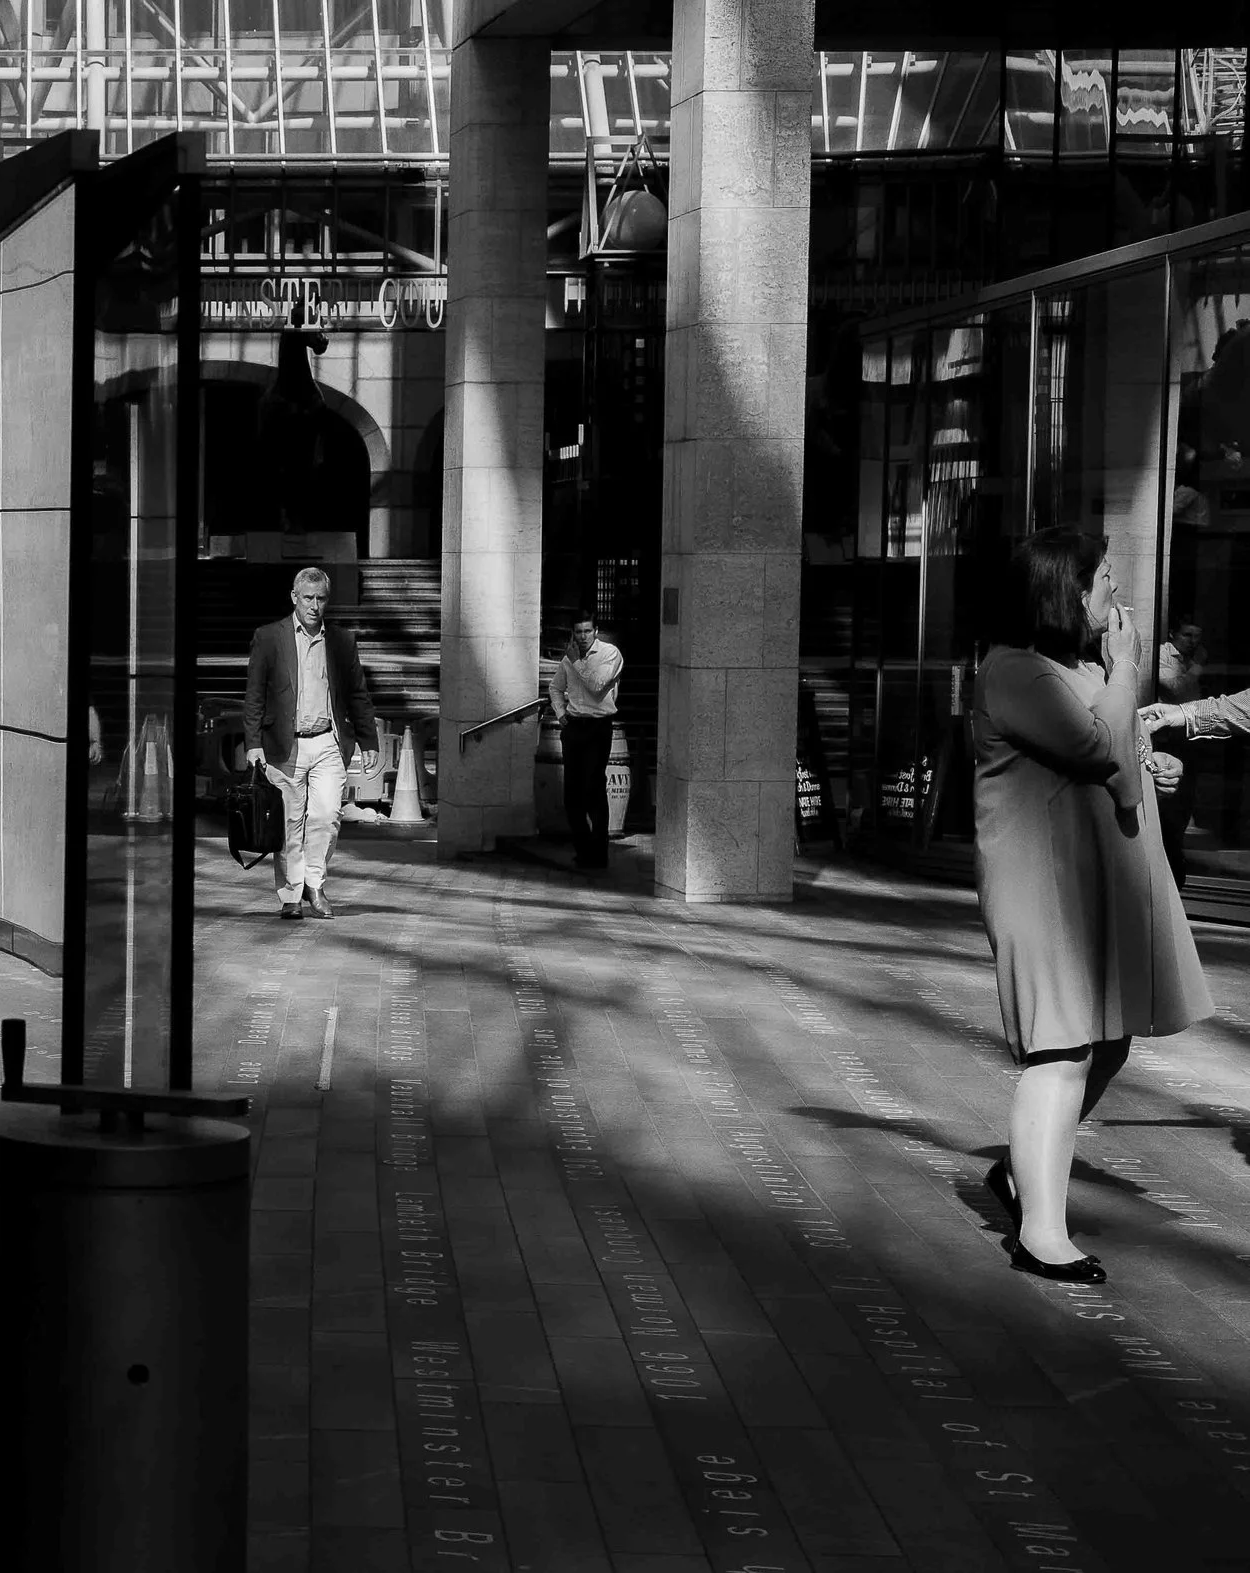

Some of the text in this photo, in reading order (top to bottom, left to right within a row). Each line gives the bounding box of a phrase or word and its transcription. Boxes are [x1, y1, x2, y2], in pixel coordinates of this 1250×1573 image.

[383, 1029, 421, 1060] Bridge
[528, 1029, 559, 1048] Jews
[956, 1025, 1002, 1053] Street
[228, 1061, 262, 1083] Lane
[536, 1055, 565, 1070] the
[539, 1078, 573, 1088] of
[831, 1051, 879, 1082] Street
[390, 1079, 424, 1126] Vauxhall
[546, 1095, 594, 1150] Expulsion
[383, 1134, 426, 1171] Bridge
[1102, 1158, 1169, 1184] Bull
[394, 1191, 438, 1241] Lambeth
[592, 1204, 644, 1264] Conquest
[395, 1251, 447, 1306] Bridge
[622, 1274, 681, 1337] Norman
[639, 1350, 709, 1400] 1066
[410, 1341, 473, 1506] Westminster
[855, 1305, 975, 1400] Hospital
[940, 1424, 1008, 1448] of
[975, 1472, 1036, 1498] St
[696, 1454, 770, 1536] siege
